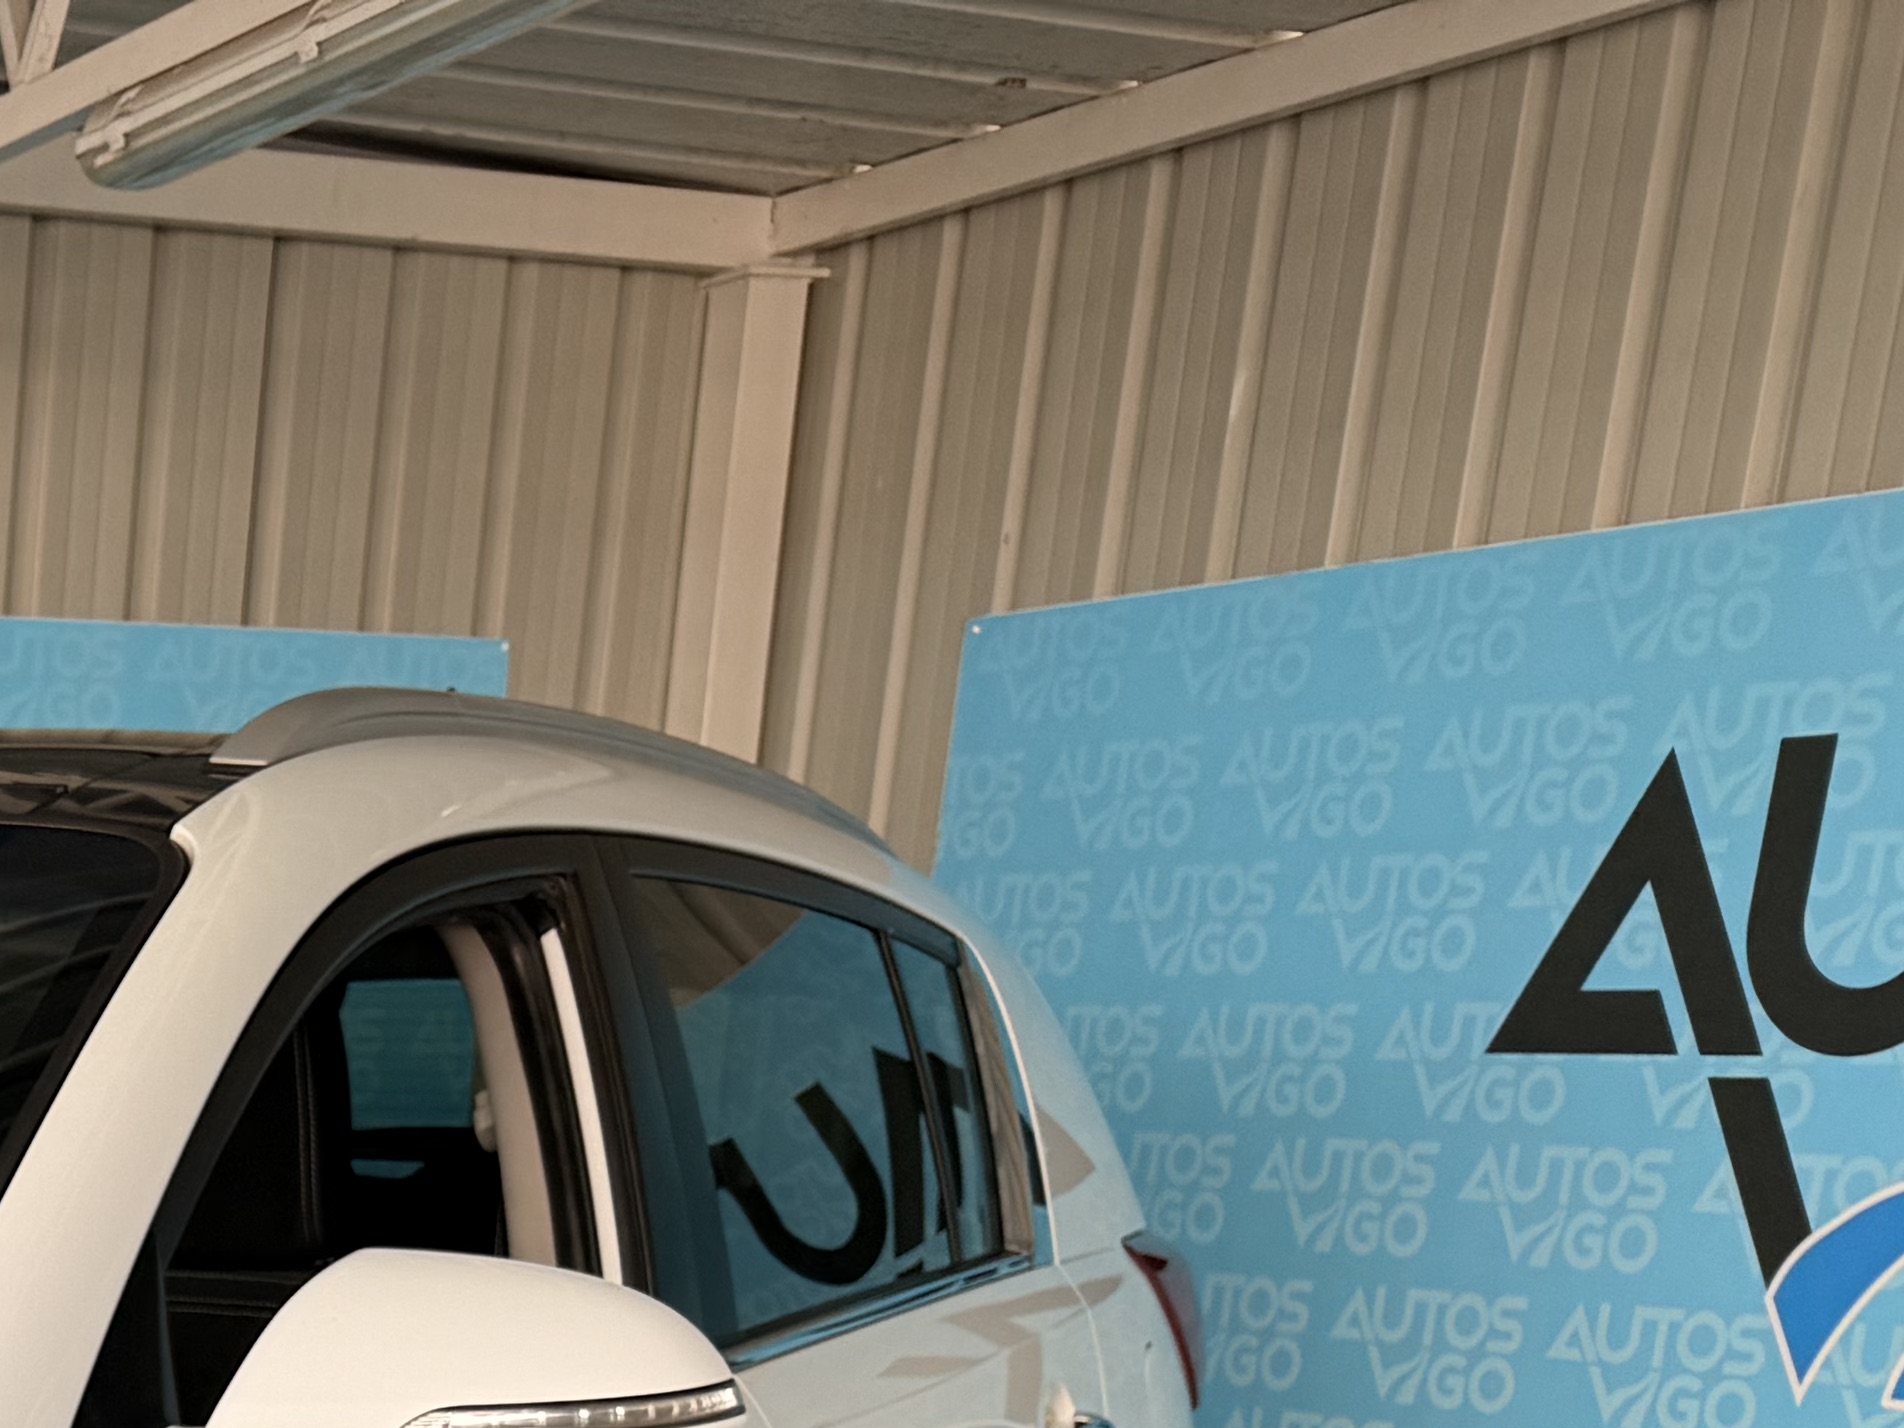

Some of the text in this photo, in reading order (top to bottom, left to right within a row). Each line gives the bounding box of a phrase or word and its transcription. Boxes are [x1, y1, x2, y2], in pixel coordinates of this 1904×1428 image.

[1345, 549, 1540, 630] AUTOS
[1562, 517, 1787, 605] AUTOS
[981, 606, 1128, 671] AUTOS
[1150, 579, 1321, 650] AUTOS
[1608, 589, 1771, 662] VIGO
[153, 635, 316, 684] AUTOS
[1181, 642, 1310, 704] VIGO
[1380, 617, 1525, 682] VIGO
[1004, 664, 1119, 721] VIGO
[1653, 673, 1891, 755] AUTOS
[1220, 716, 1403, 785] AUTOS
[1425, 696, 1631, 769] AUTOS
[1044, 734, 1202, 798] AUTOS
[1465, 764, 1617, 827] VIGO
[1071, 795, 1191, 849] VIGO
[1256, 780, 1391, 840] VIGO
[1109, 861, 1278, 921] AUTOS
[1295, 851, 1489, 915] AUTOS
[1142, 922, 1266, 975] VIGO
[1333, 915, 1475, 972] VIGO
[1178, 1003, 1357, 1058] AUTOS
[1212, 1060, 1344, 1117] VIGO
[1415, 1064, 1565, 1123] VIGO
[1253, 1139, 1438, 1197] AUTOS
[1459, 1144, 1672, 1208] AUTOS
[1292, 1197, 1425, 1256] VIGO
[1501, 1207, 1655, 1272] VIGO
[1331, 1285, 1526, 1352] AUTOS
[1547, 1304, 1768, 1375] AUTOS
[1370, 1346, 1513, 1412] VIGO
